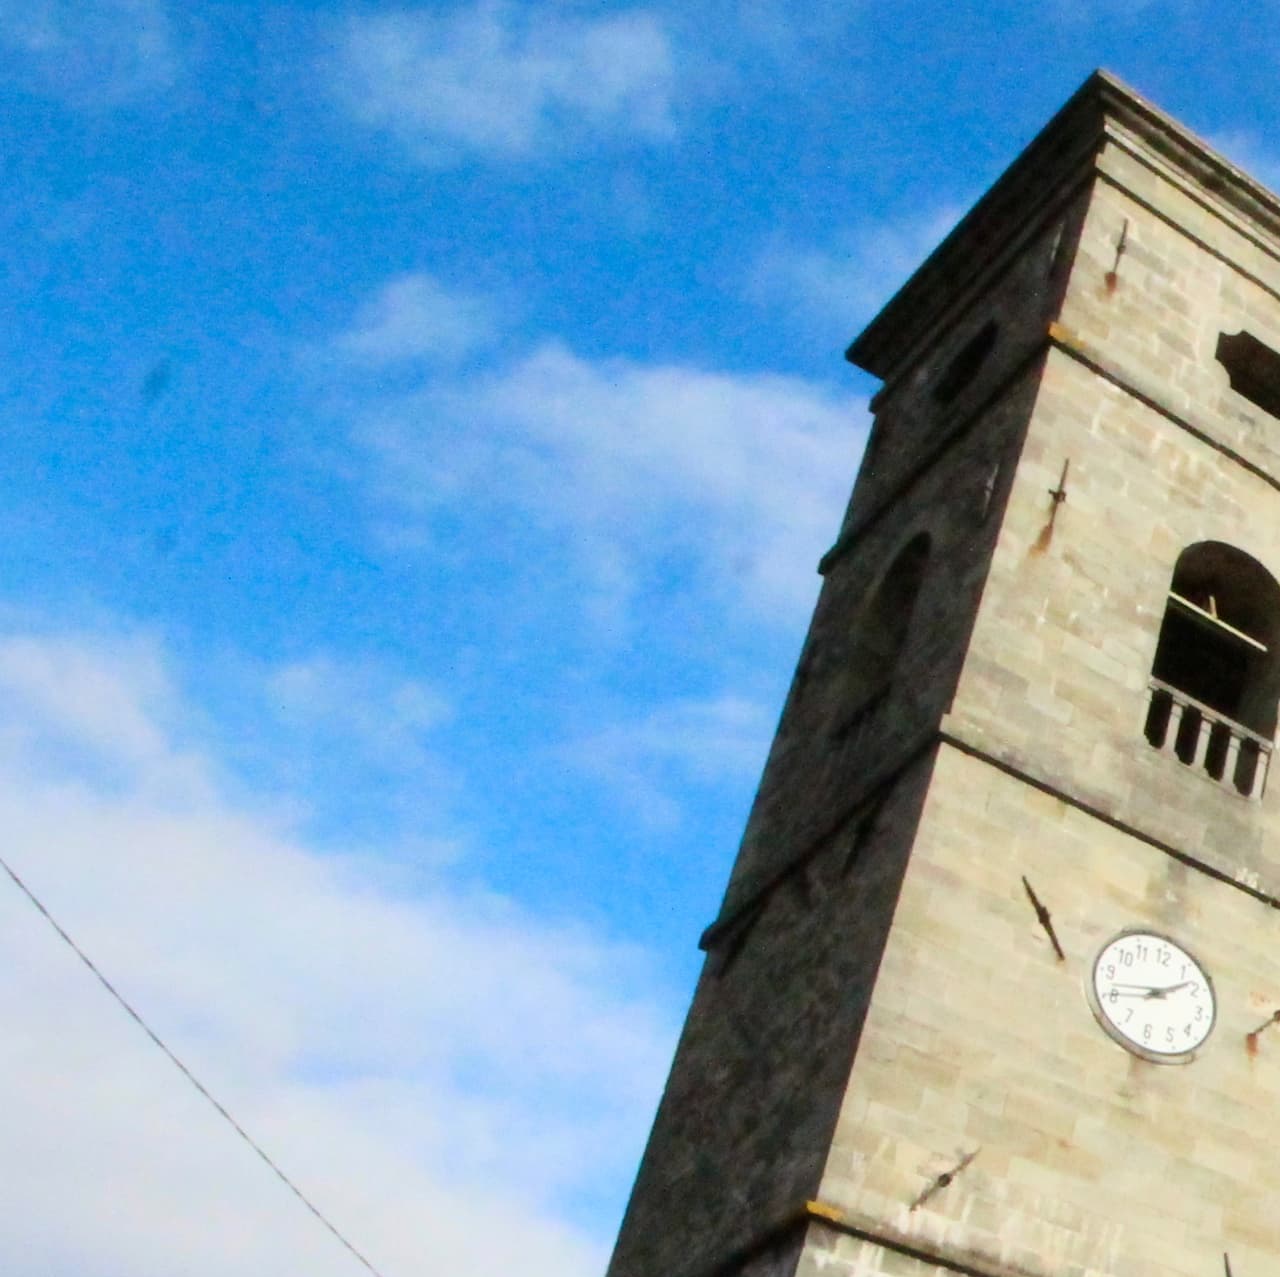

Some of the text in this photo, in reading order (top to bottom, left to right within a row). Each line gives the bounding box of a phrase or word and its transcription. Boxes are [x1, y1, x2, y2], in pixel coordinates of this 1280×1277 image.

[1119, 950, 1133, 967] 10
[1136, 945, 1148, 962] 11
[1156, 948, 1171, 966] 12
[1106, 965, 1115, 979] 9
[1181, 965, 1186, 979] 1
[1110, 989, 1118, 1003] 8
[1191, 983, 1199, 997] 2
[1124, 1008, 1134, 1023] 7
[1195, 1006, 1203, 1022] 3
[1144, 1024, 1152, 1038] 6
[1166, 1027, 1175, 1042] 5
[1184, 1024, 1191, 1037] 4
